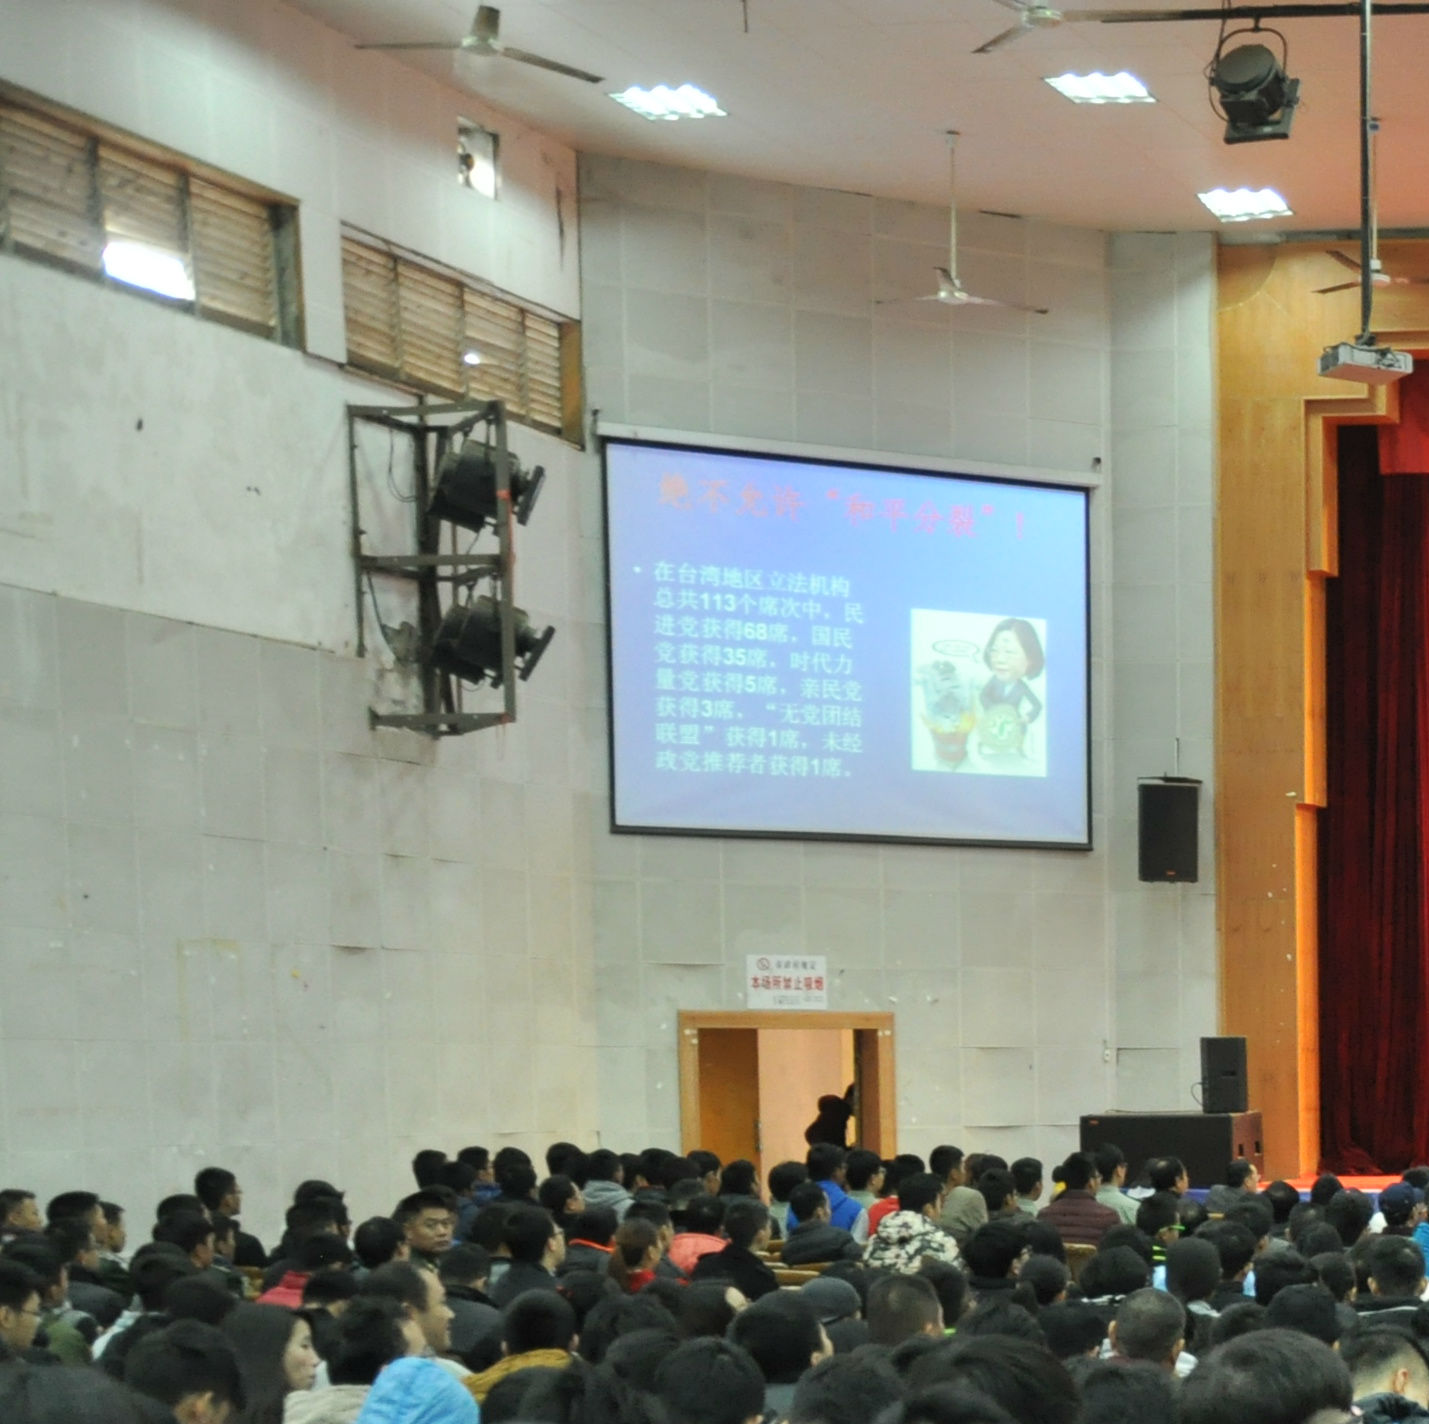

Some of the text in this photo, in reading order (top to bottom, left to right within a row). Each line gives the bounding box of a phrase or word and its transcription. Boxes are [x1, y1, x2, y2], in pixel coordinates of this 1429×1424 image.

[654, 561, 851, 597] 在台湾地区立法机构
